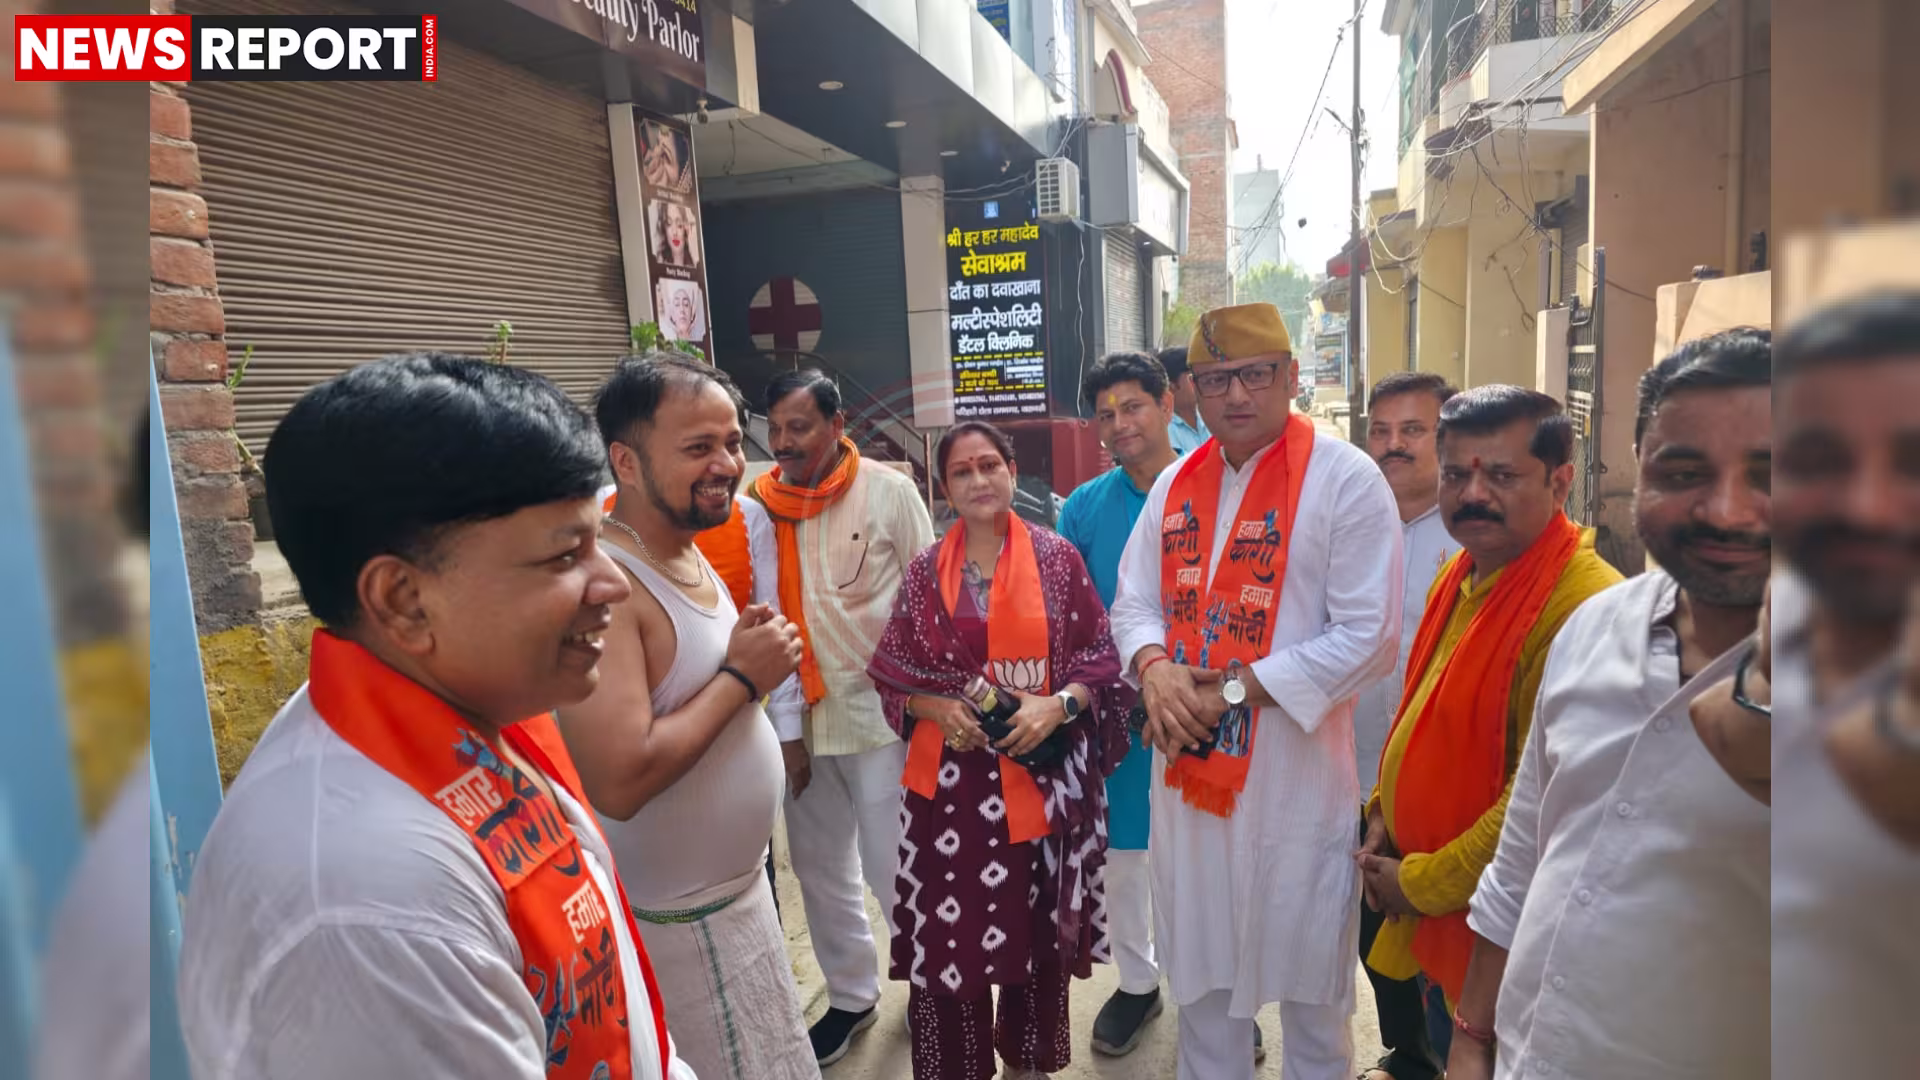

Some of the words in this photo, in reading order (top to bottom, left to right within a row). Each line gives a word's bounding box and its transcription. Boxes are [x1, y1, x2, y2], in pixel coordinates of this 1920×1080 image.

[570, 0, 639, 42] auty
[641, 0, 700, 62] Parlor
[947, 227, 962, 247] श्री
[964, 231, 980, 247] हर
[982, 229, 998, 245] हर
[1000, 220, 1039, 243] महादेव
[961, 248, 1027, 276] सेवाश्रम
[972, 283, 989, 299] का
[991, 280, 1041, 298] दवाखाना
[951, 302, 1042, 331] मल्टीस्पेशलिटी
[987, 330, 1035, 352] क्लिनिक
[1163, 512, 1186, 532] हमार
[1236, 520, 1266, 539] हमार
[1229, 530, 1281, 583] काशी
[1176, 567, 1202, 588] हमार
[1239, 584, 1275, 609] हमार
[1228, 604, 1267, 660] मोदी
[434, 766, 503, 827] हमार
[475, 766, 581, 877] काशी
[561, 879, 606, 944] हमार
